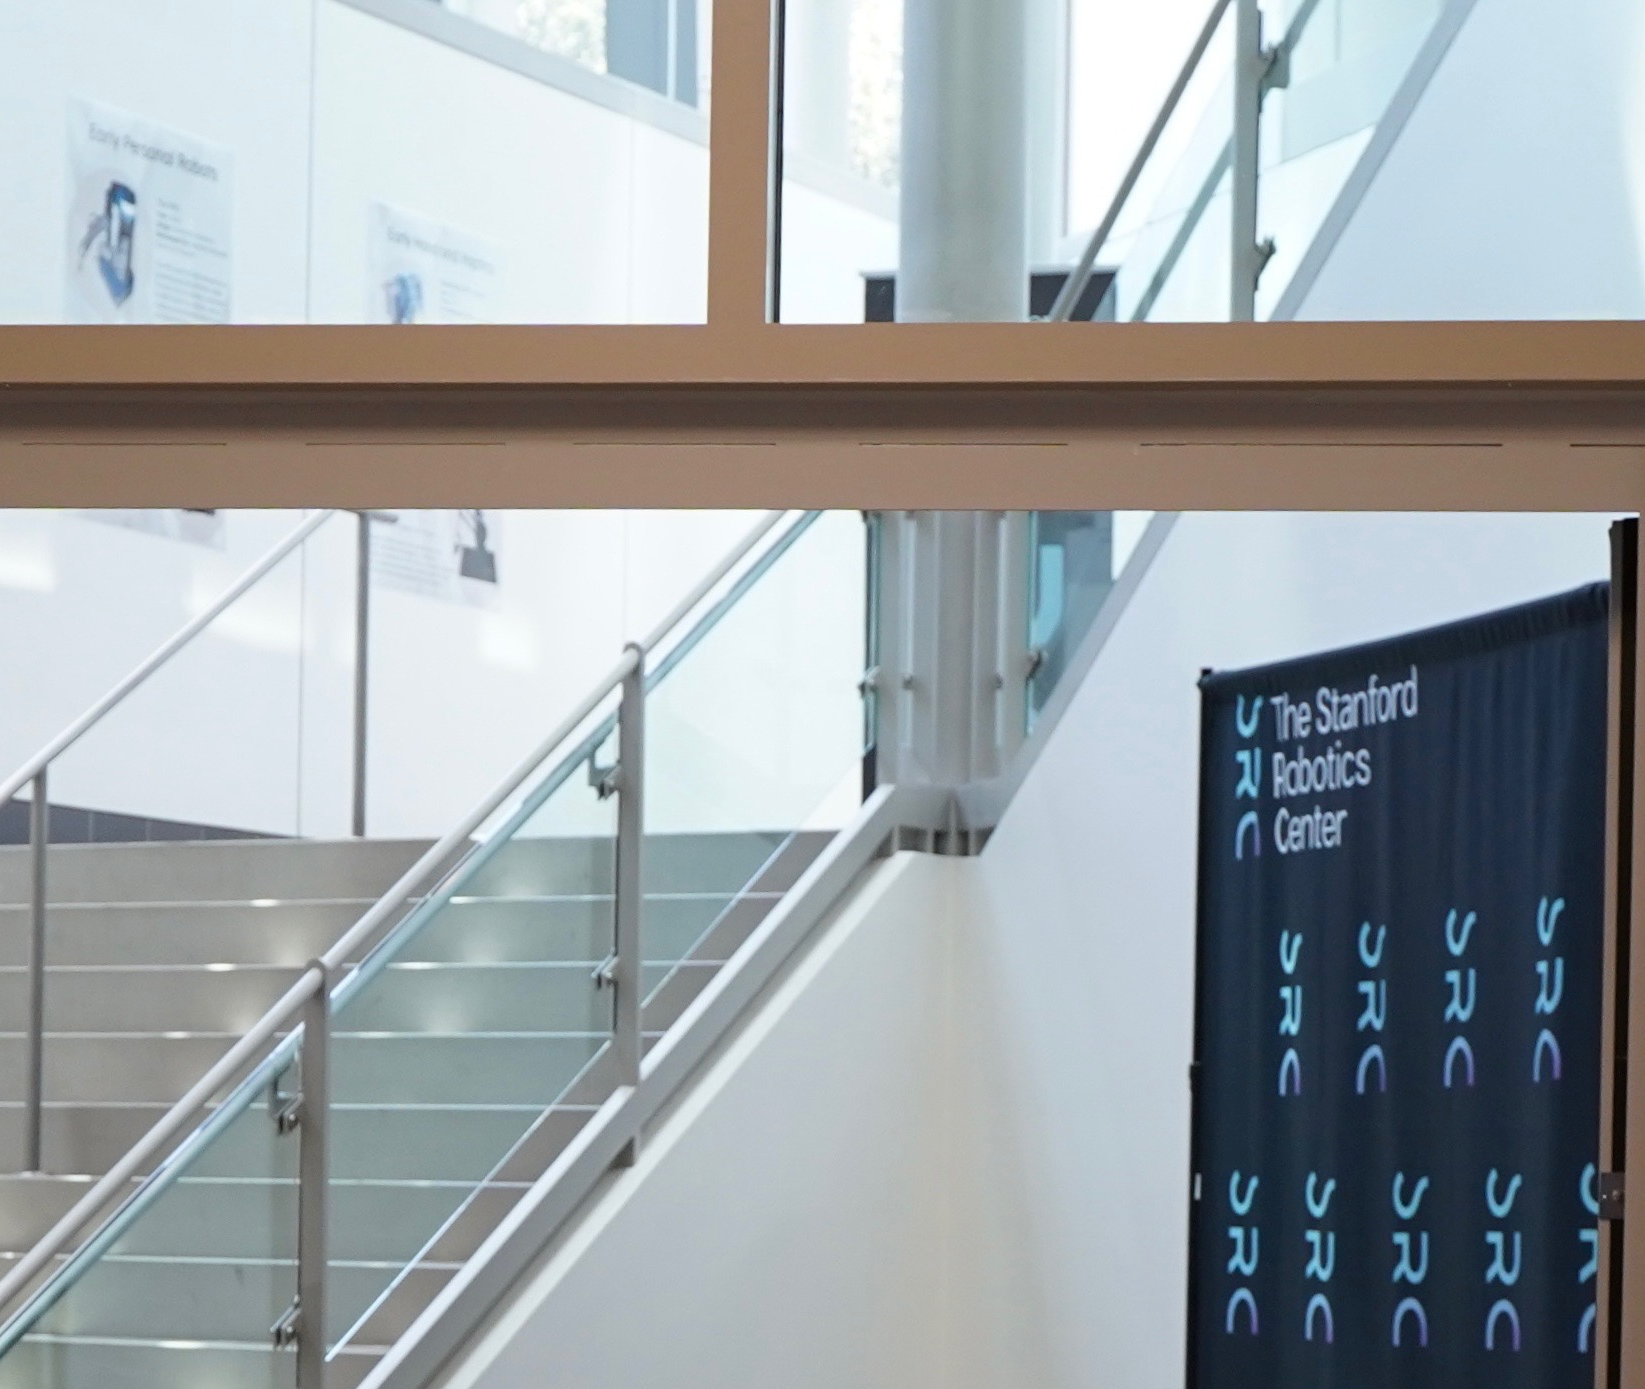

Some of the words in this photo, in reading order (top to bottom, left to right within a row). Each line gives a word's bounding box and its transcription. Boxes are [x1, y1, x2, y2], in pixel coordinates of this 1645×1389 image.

[1235, 694, 1264, 861] SRC
[1269, 692, 1312, 741] The
[1315, 664, 1419, 735] Stanford
[1272, 740, 1372, 799] Robotics
[1274, 804, 1348, 854] Center
[1279, 930, 1305, 1097] SRC
[1356, 922, 1389, 1096] SRC
[1443, 909, 1478, 1089] SRC
[1533, 897, 1566, 1084] SRC
[1226, 1171, 1261, 1335] SRC
[1305, 1172, 1338, 1344] SRC
[1392, 1172, 1431, 1348] SRC
[1485, 1169, 1524, 1351] SRC
